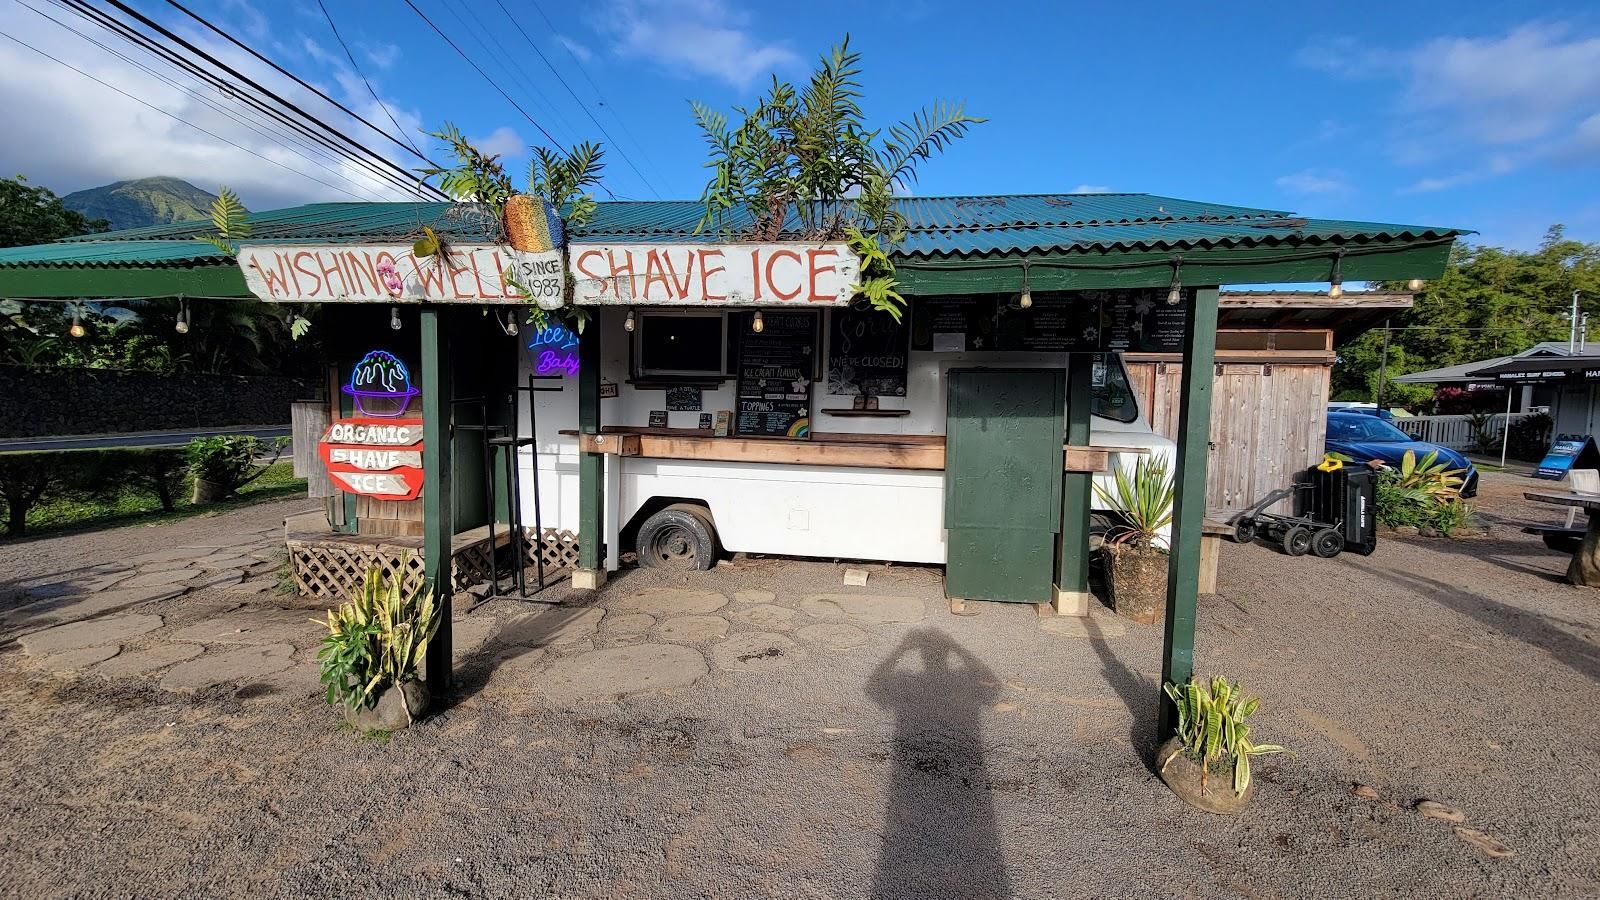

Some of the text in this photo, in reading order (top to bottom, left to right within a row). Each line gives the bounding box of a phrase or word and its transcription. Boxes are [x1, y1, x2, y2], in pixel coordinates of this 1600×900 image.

[250, 250, 532, 299] WISHING WELL
[521, 260, 561, 276] SINCE
[576, 248, 839, 302] SHAVE ICE
[528, 279, 561, 297] 1983
[528, 327, 564, 348] Ice
[537, 350, 579, 374] Baby
[861, 355, 904, 369] CLOSED!
[743, 368, 754, 377] ICE
[754, 368, 775, 377] CREAM
[741, 401, 774, 411] TOPPINGS
[331, 424, 410, 443] ORGANIC
[333, 450, 400, 468] SHAVE
[350, 475, 388, 492] ICE
